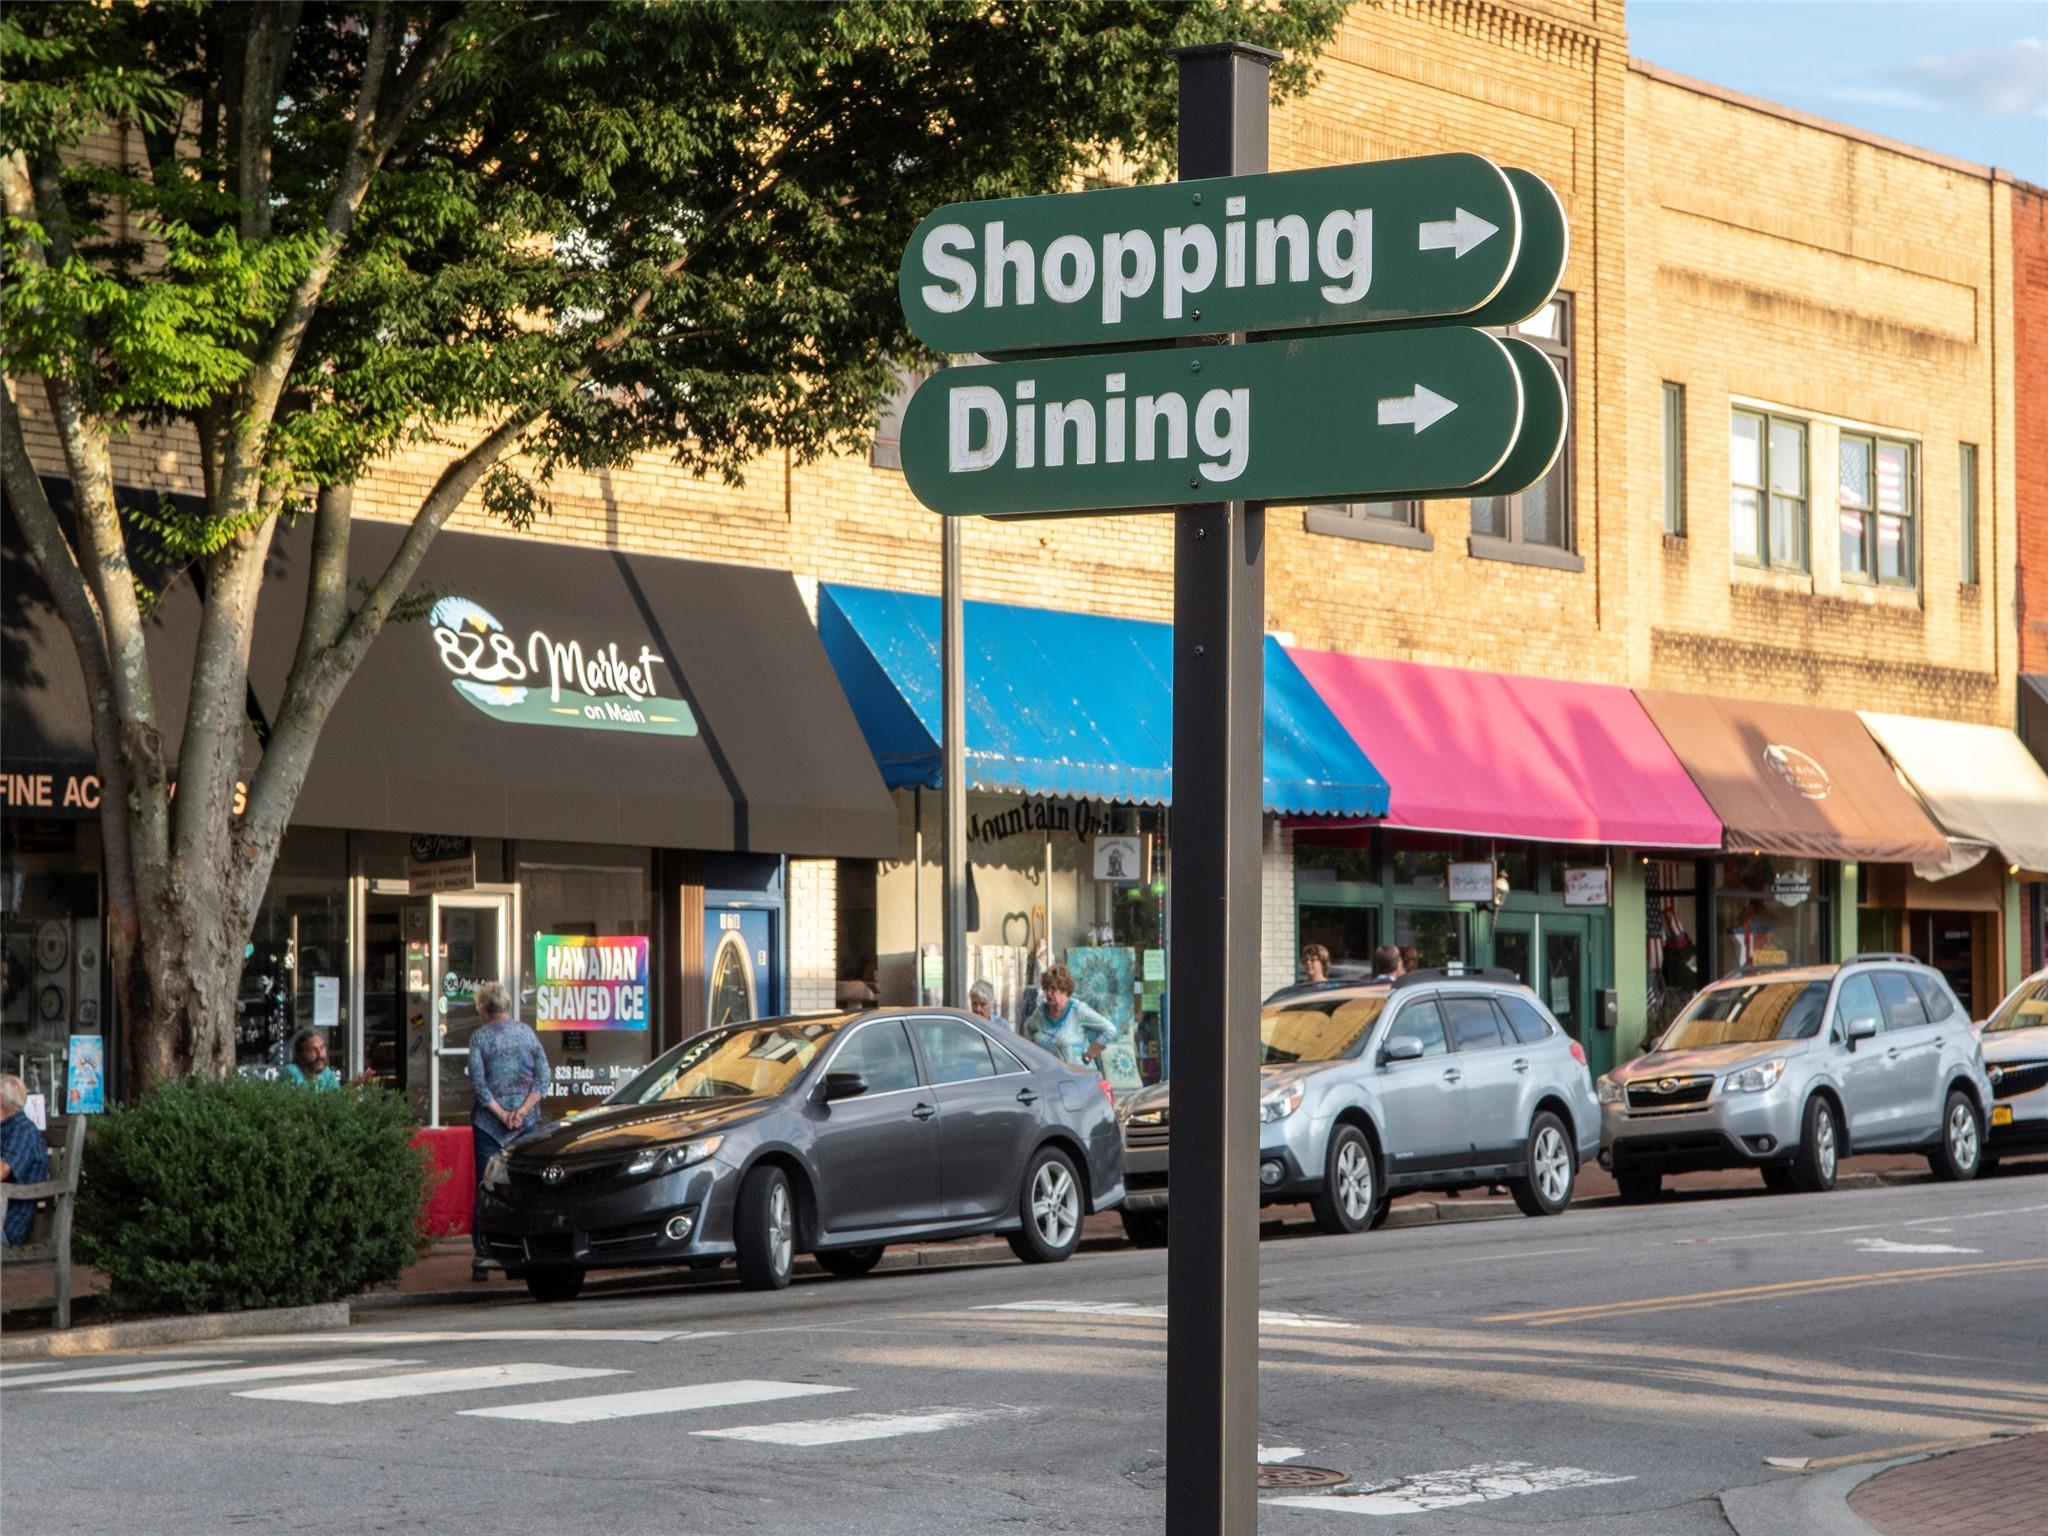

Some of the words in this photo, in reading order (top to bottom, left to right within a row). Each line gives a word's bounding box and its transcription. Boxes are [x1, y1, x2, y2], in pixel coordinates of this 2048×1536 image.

[921, 195, 1373, 324] Shopping
[948, 372, 1250, 482] Dining
[433, 626, 526, 682] 828
[528, 631, 664, 703] Market
[584, 705, 606, 720] on
[608, 702, 647, 723] Main
[546, 945, 638, 980] HAWAIIAN
[537, 985, 611, 1021] SHAVED
[614, 985, 645, 1021] ICE
[555, 1065, 572, 1080] 828
[573, 1065, 594, 1080] Hats
[555, 1082, 569, 1097] Ice
